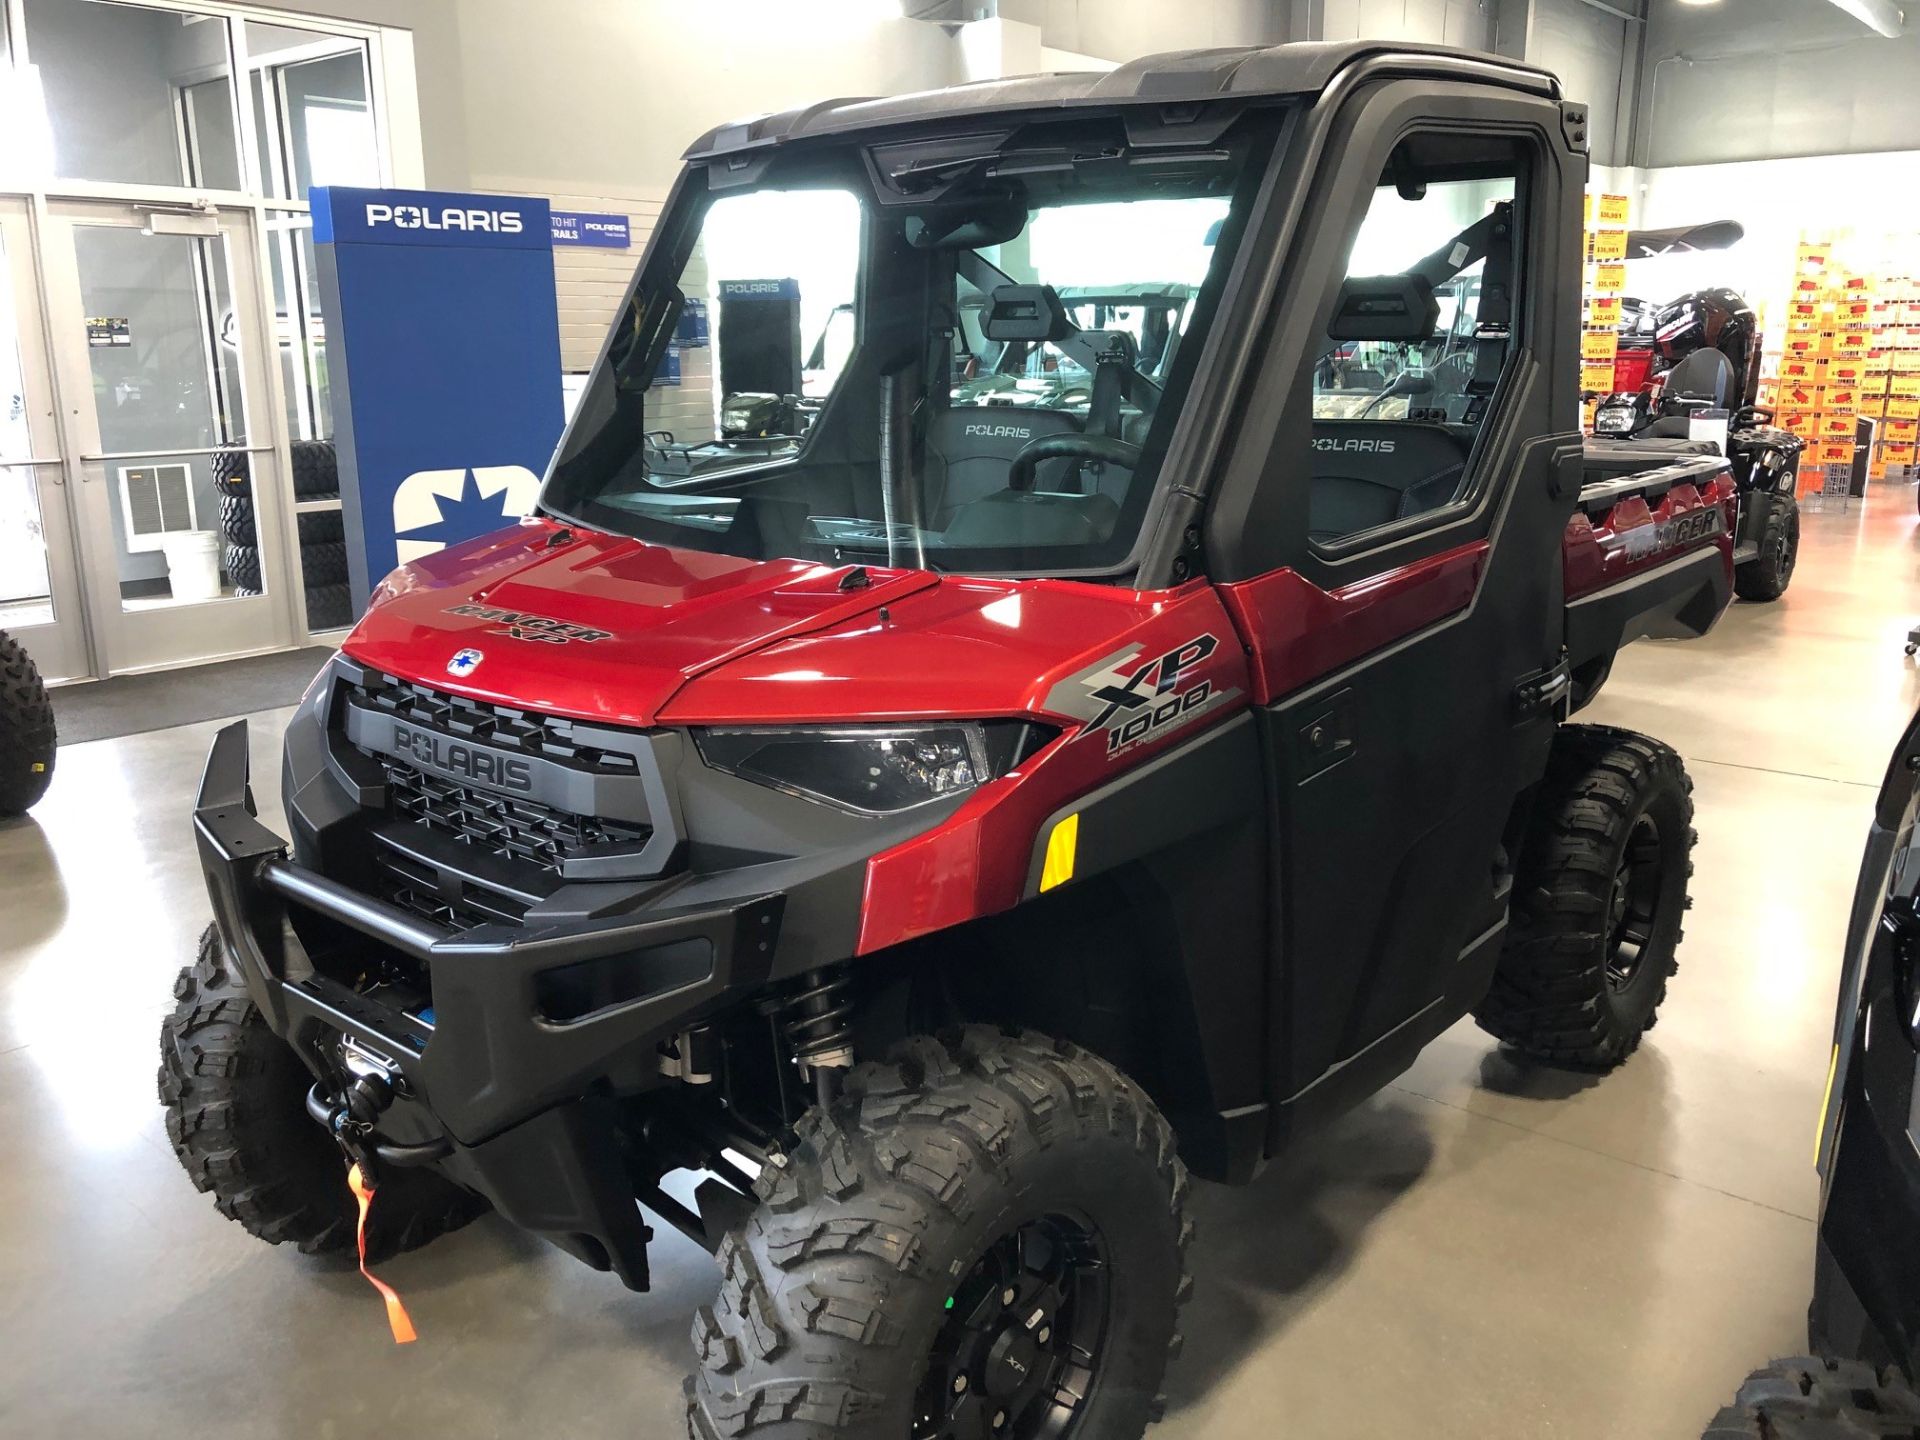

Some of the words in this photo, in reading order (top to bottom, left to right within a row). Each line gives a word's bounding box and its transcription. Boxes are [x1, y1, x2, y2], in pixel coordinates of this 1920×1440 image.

[366, 204, 523, 233] POLARIS
[551, 216, 562, 227] TO
[564, 218, 577, 228] HIT
[551, 229, 578, 239] TRAILS
[585, 223, 627, 232] POLARIS
[726, 283, 780, 294] POLARIS
[966, 424, 1031, 439] POLARIS
[441, 604, 614, 643] RANGER
[483, 626, 569, 645] XP
[1067, 632, 1220, 745] XP
[1107, 679, 1212, 754] 1000
[394, 724, 532, 793] POLARIS
[1107, 744, 1134, 761] DUAL
[1006, 1355, 1025, 1372] XP
